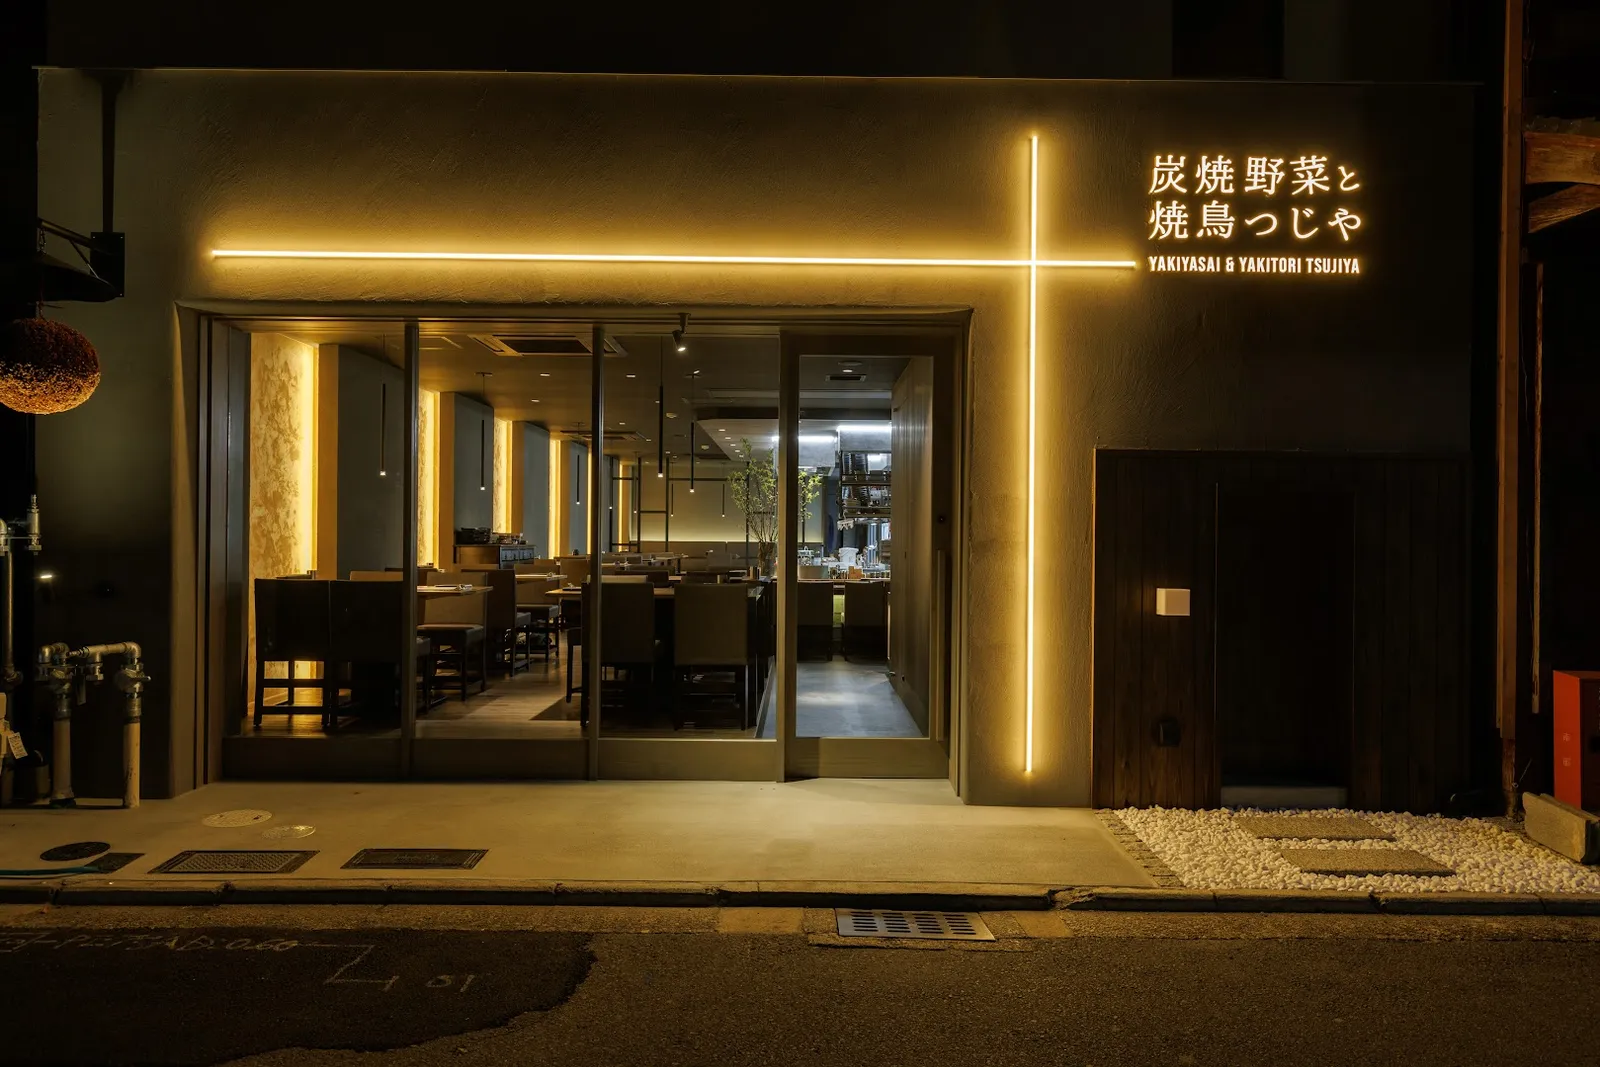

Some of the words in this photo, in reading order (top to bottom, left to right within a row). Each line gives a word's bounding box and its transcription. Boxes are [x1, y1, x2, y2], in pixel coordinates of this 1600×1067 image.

[1149, 154, 1360, 196] 炭焼野菜と
[1149, 199, 1362, 242] 焼鳥つじや
[1148, 255, 1221, 273] YAKIYASAI
[1225, 256, 1235, 273] &
[1238, 256, 1302, 274] YAKITORI
[1305, 257, 1360, 274] TSUJIYA
